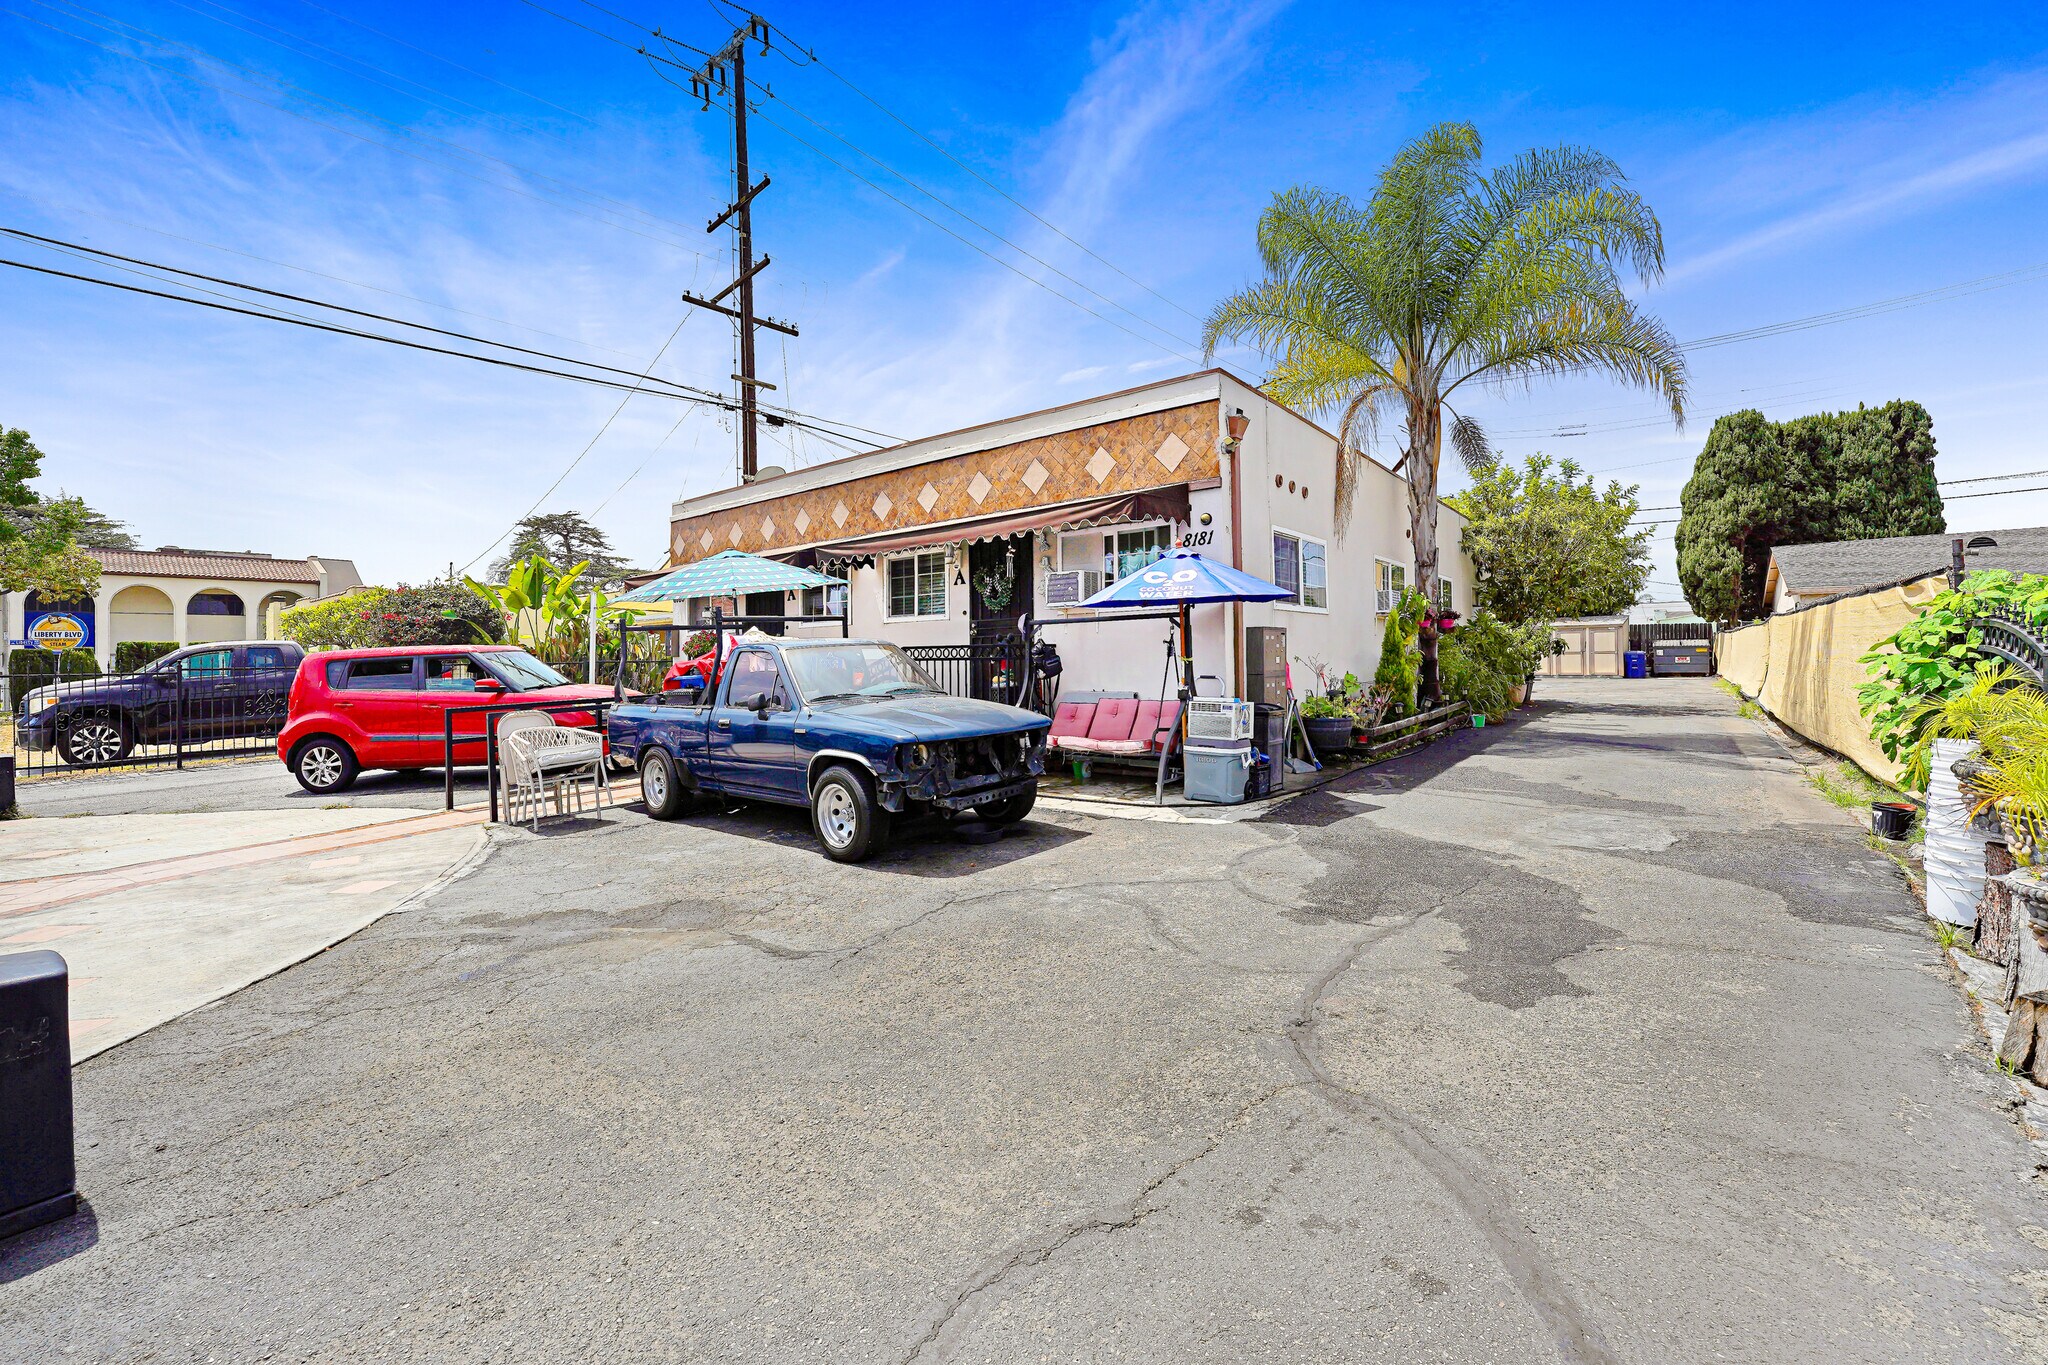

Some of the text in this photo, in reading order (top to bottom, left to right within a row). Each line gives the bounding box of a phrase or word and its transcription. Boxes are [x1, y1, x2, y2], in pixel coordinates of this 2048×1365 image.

[1182, 530, 1214, 547] 8181
[953, 569, 967, 585] A
[787, 589, 797, 601] A
[1138, 590, 1194, 599] WATER
